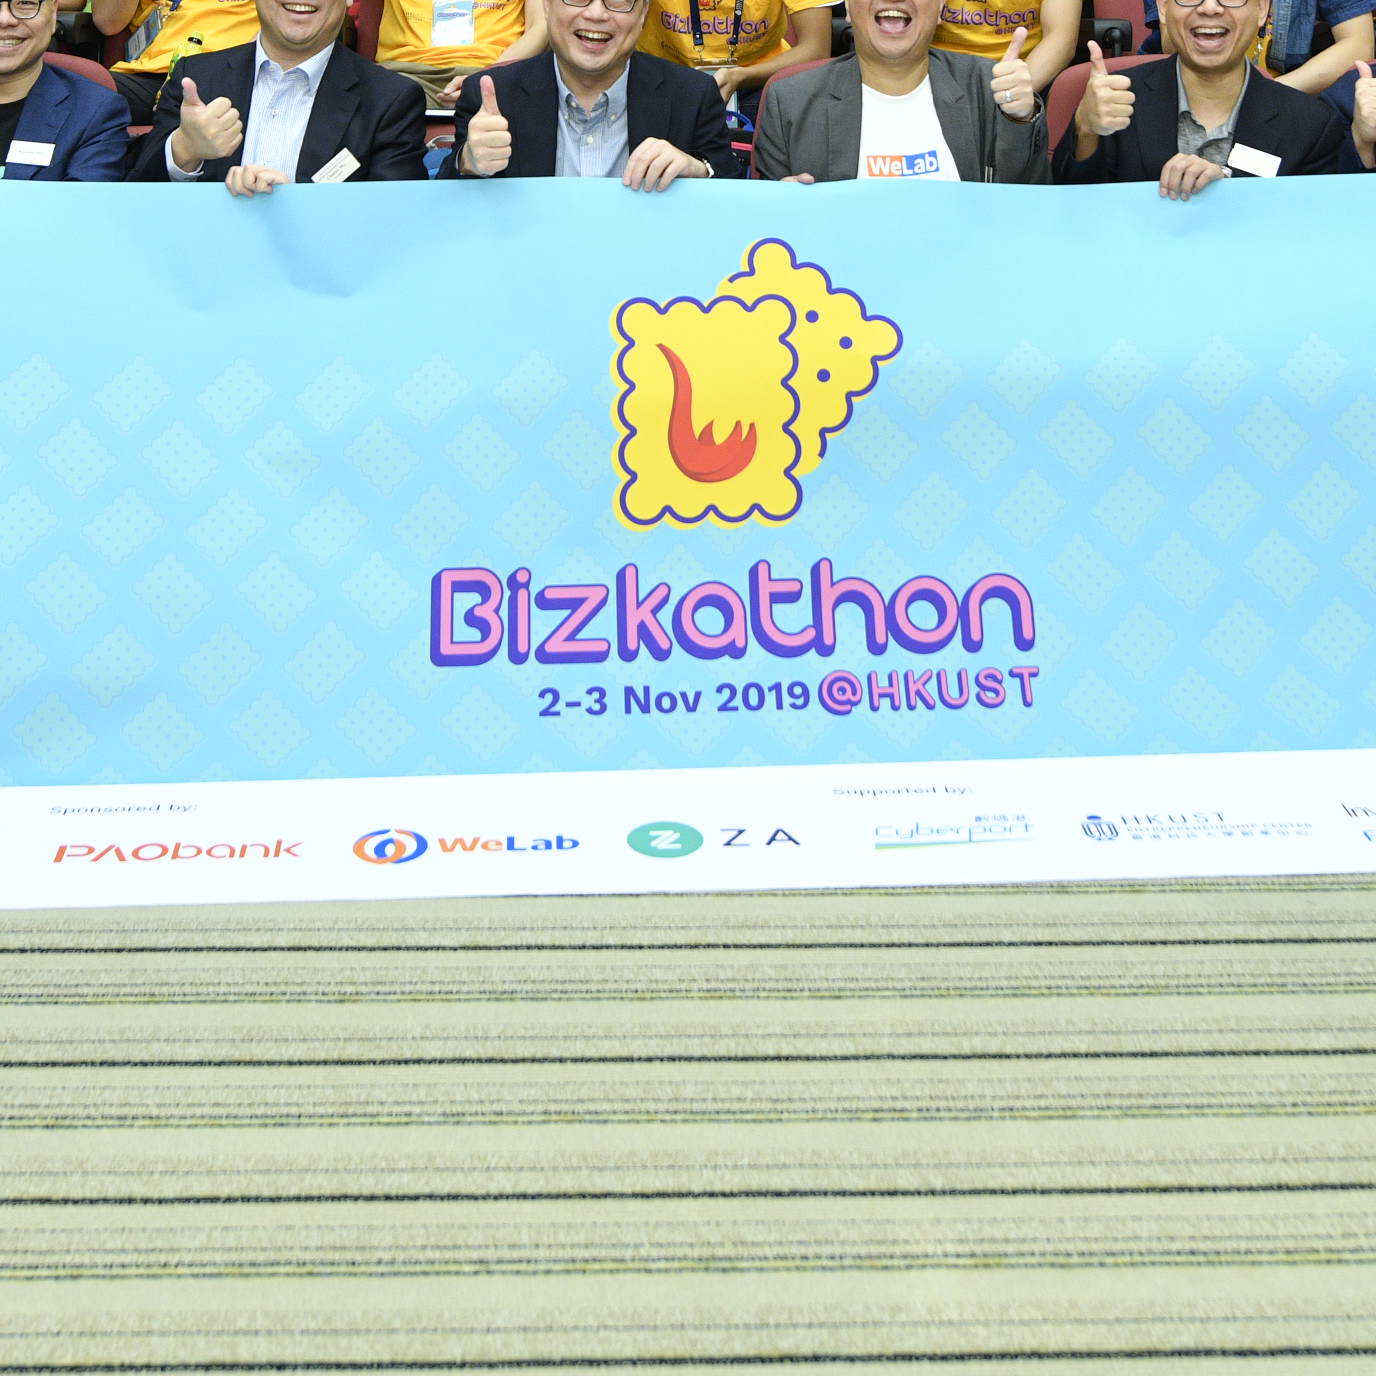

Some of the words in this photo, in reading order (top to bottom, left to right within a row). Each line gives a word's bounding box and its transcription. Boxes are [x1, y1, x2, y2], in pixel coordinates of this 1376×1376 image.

[940, 4, 1038, 27] izkathon
[868, 154, 939, 176] WeLab
[429, 557, 1036, 667] Bizkathon
[537, 685, 608, 717] 2-3
[623, 684, 702, 715] Nov
[716, 680, 810, 713] 2019
[817, 665, 1040, 716] @HKUST
[50, 803, 161, 816] Sponsored
[437, 835, 580, 853] WeLab
